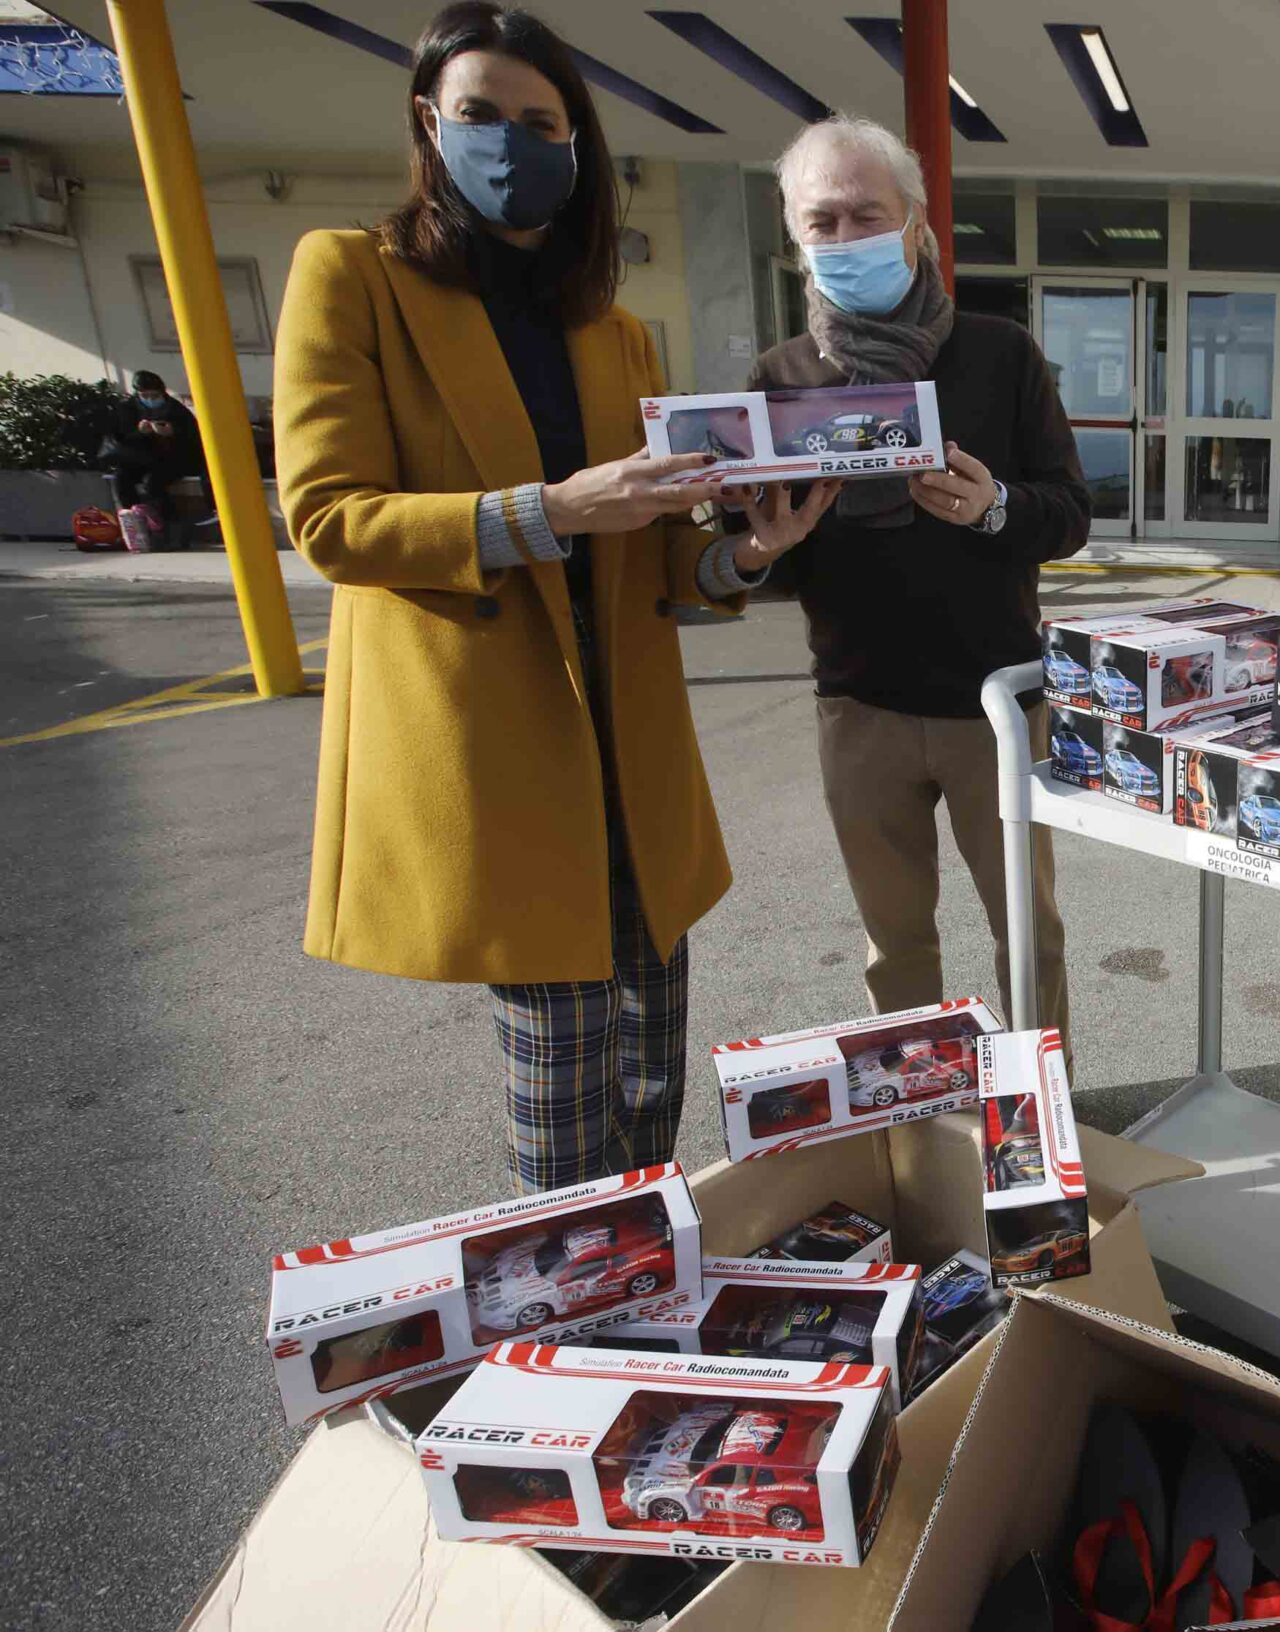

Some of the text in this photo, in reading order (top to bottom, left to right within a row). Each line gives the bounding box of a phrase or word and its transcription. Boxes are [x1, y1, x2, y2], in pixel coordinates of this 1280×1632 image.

[840, 428, 858, 440] 98
[820, 454, 937, 473] RACER CAR
[1092, 706, 1122, 722] RACER
[1122, 715, 1143, 729] CAR
[1052, 768, 1081, 783] RACER
[1105, 787, 1161, 812] RACER CAR
[1176, 751, 1186, 825] RACER CAR
[1207, 845, 1273, 871] ONCOLOGIA
[1238, 839, 1280, 856] RACER
[1207, 858, 1270, 884] PEDIATRICA
[724, 1054, 838, 1084] RACER CAR
[982, 1036, 994, 1094] RACER CAR
[892, 1100, 956, 1122] RACER
[384, 1186, 598, 1244] Simulation Racer Car Radiocomandata
[849, 1213, 884, 1235] RACER
[713, 1261, 844, 1276] Racer Car Radiocomandata
[923, 1258, 962, 1290] RACER
[997, 1263, 1088, 1285] RACER CAR
[275, 1276, 456, 1333] RACER CAR
[537, 1293, 691, 1345] RACER CAR
[650, 1313, 697, 1324] CAR
[579, 1356, 790, 1380] Simulation Racer Car Radiocomandata
[425, 1425, 592, 1449] RACER CAR
[673, 1542, 844, 1565] RACER CAR
